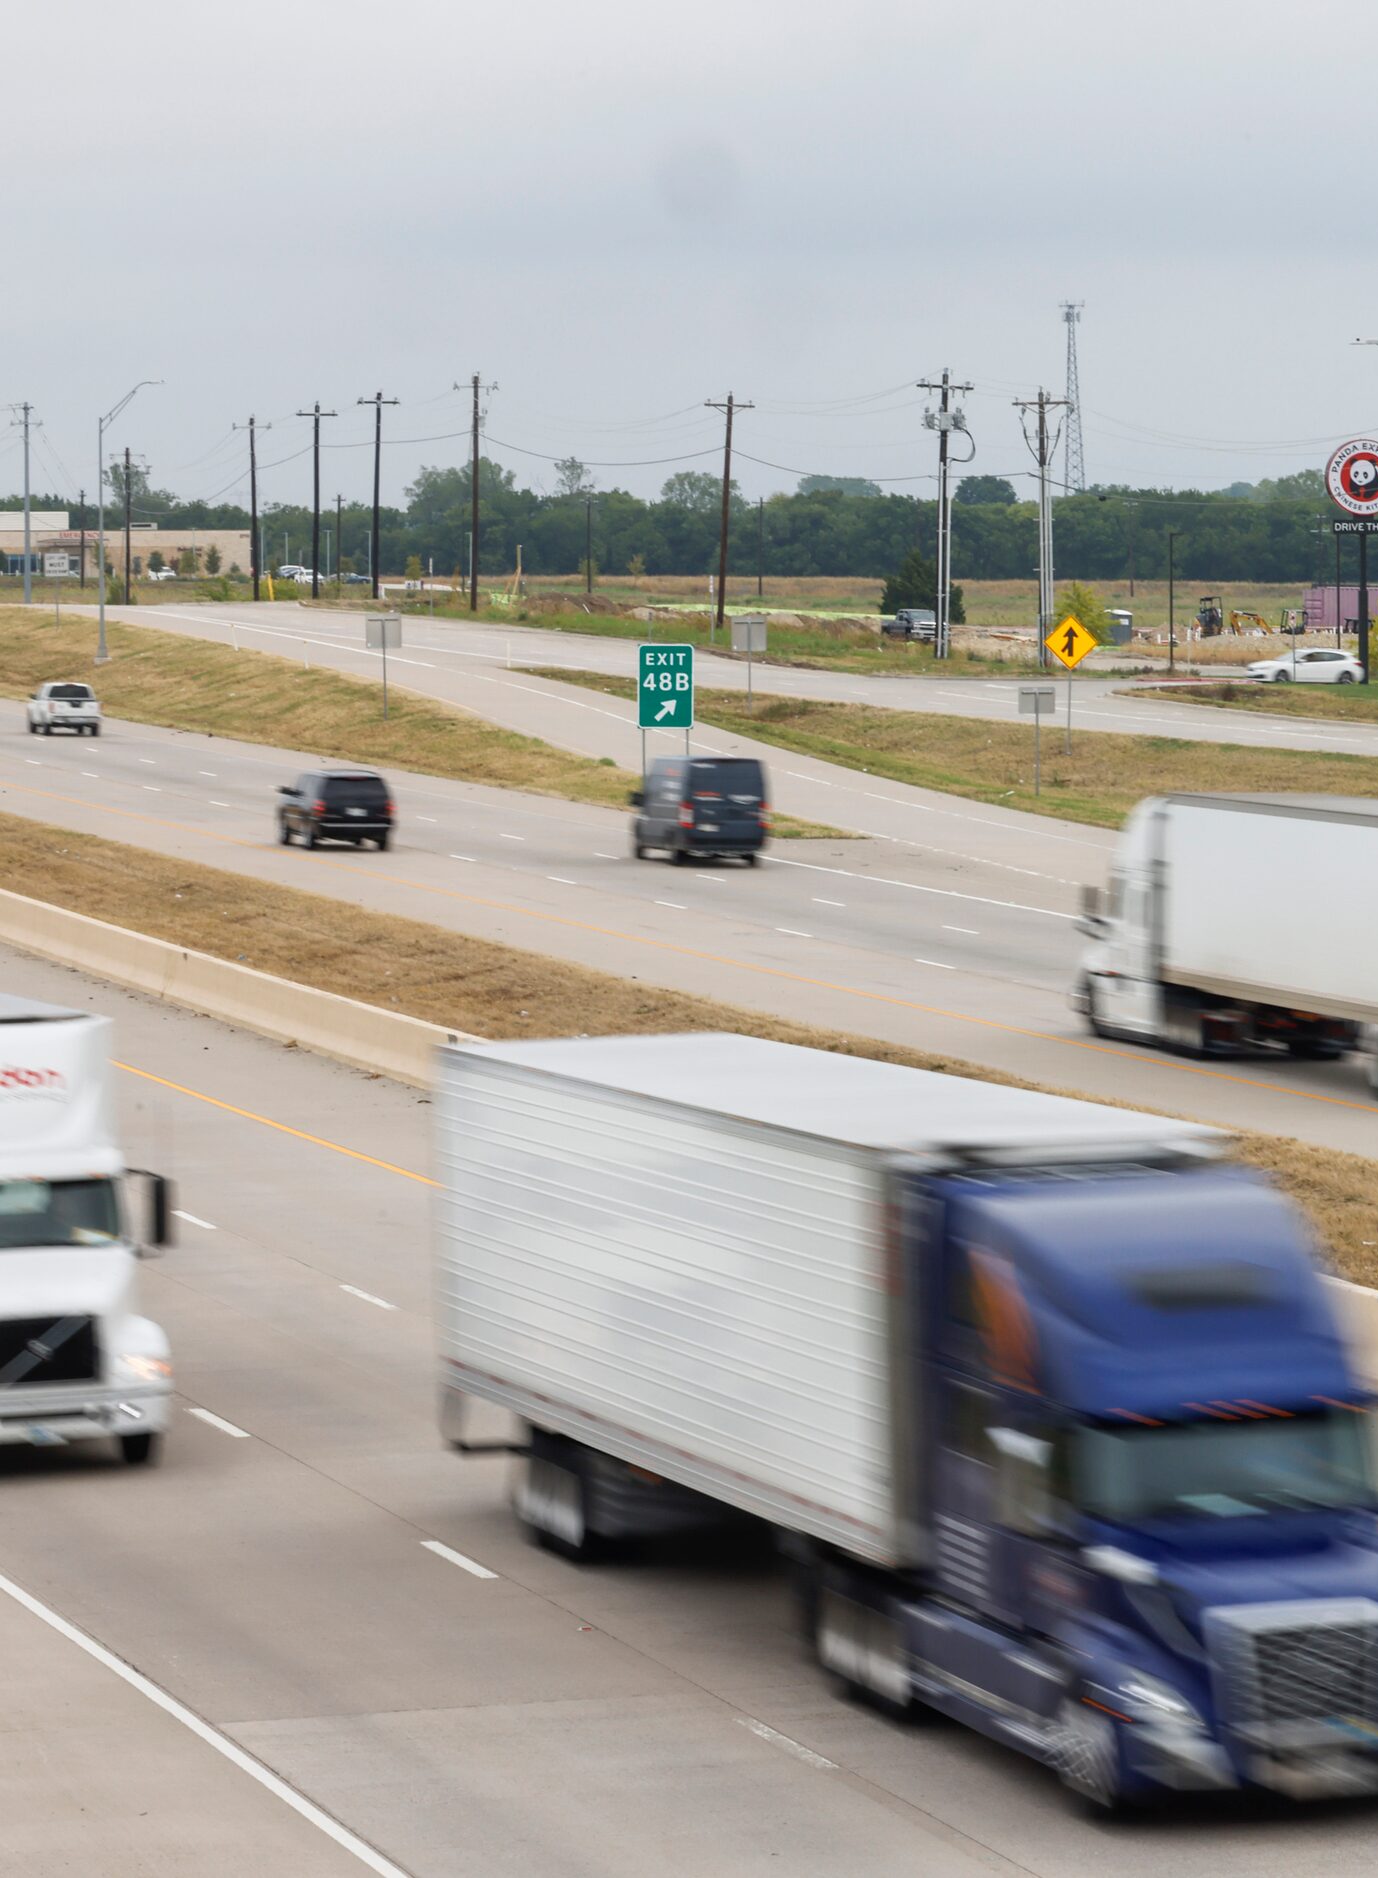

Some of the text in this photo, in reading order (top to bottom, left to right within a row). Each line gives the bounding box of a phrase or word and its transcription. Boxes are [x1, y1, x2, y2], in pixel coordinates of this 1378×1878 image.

[1332, 444, 1360, 474] PANDA
[1334, 486, 1362, 511] CHINESE
[1334, 522, 1364, 531] DRIVE
[645, 653, 686, 666] EXIT
[642, 672, 690, 691] 48B
